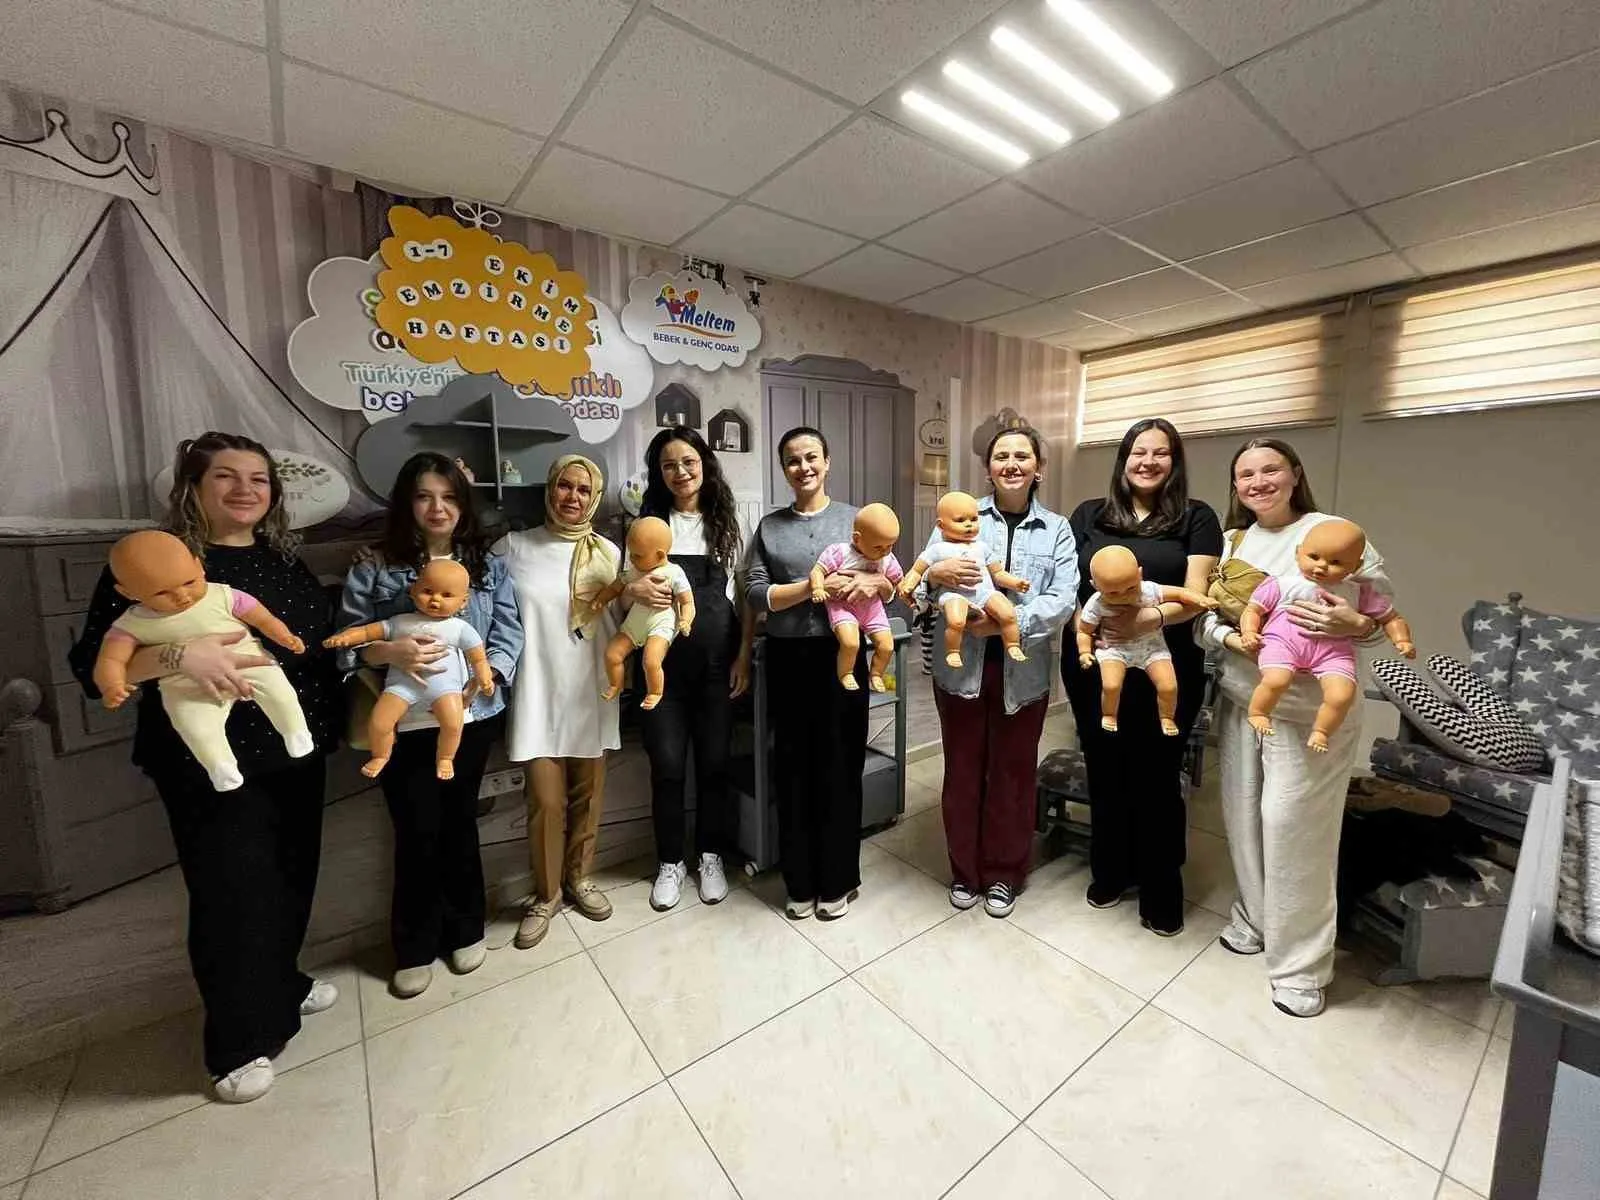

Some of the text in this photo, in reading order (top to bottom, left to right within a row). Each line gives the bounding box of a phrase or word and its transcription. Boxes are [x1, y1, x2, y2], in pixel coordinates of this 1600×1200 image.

[409, 244, 450, 258] 1-7
[680, 304, 736, 333] Meltem
[407, 321, 567, 350] HAFTASI
[653, 332, 681, 345] BEBEK
[690, 338, 713, 351] GENÇ
[714, 342, 740, 353] ODASI
